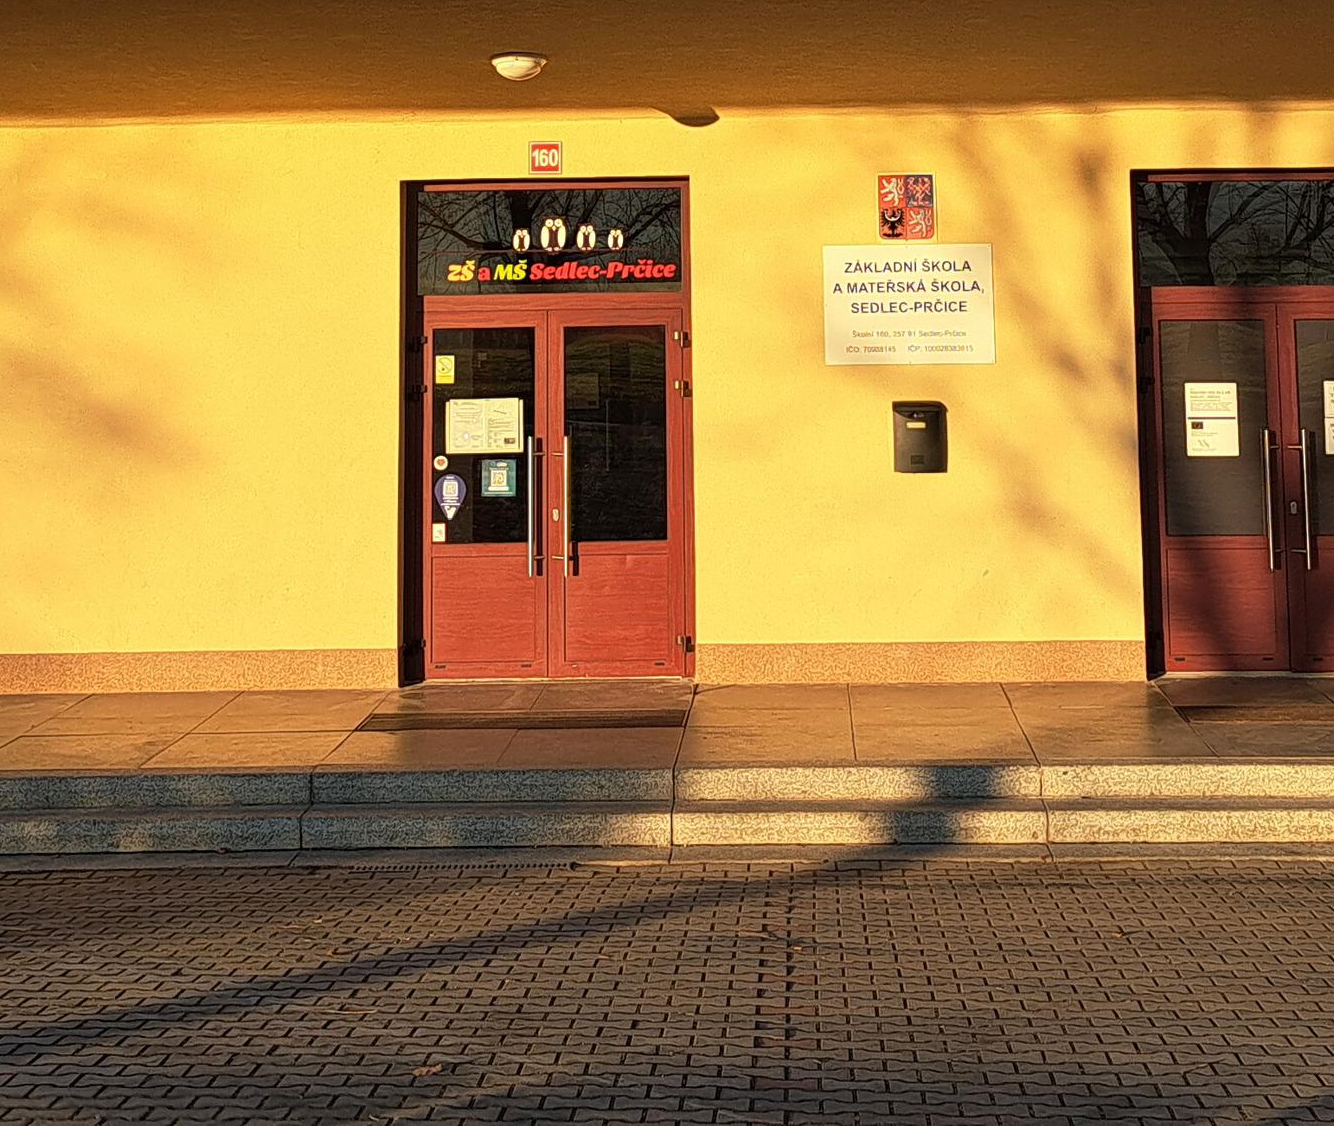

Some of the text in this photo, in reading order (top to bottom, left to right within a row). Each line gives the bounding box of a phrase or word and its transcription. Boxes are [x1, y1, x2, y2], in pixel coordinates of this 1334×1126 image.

[532, 148, 559, 167] 160
[447, 259, 677, 281] ZŠ a MŠ Sedlec-Prčice
[844, 258, 972, 274] ZÁKLADNÍ ŠKOLA
[833, 279, 985, 294] A MATEŘSKÁ ŠKOLA,
[851, 299, 968, 314] SEDLEC-PRČICE
